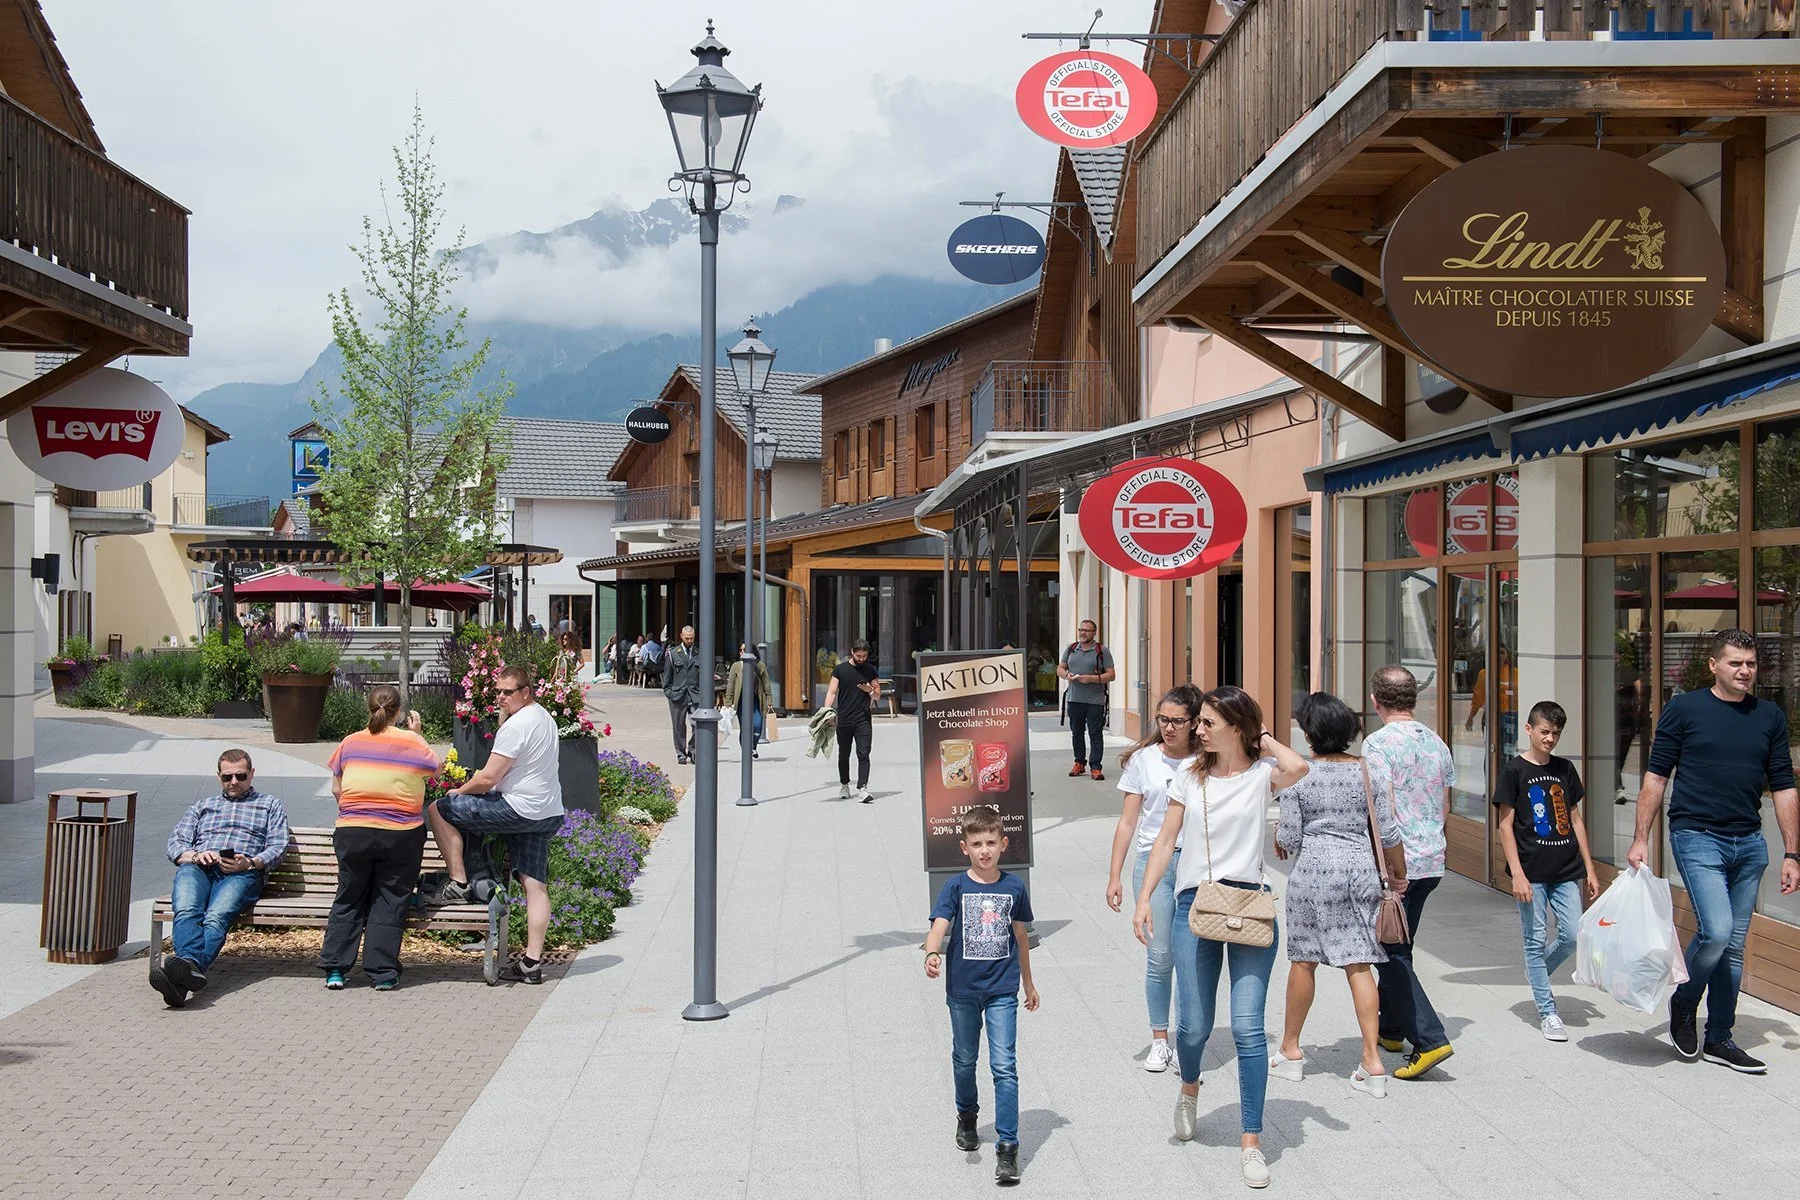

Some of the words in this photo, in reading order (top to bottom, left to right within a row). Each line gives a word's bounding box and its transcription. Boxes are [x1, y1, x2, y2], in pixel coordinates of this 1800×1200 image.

[1049, 61, 1090, 87] OFFICIAL
[1092, 62, 1123, 87] STORE
[1046, 91, 1128, 107] Tefal
[1050, 112, 1093, 138] OFFICIAL
[1095, 112, 1124, 137] STORE
[954, 244, 1039, 254] SKECHERS
[1442, 211, 1623, 270] Lindt
[1413, 286, 1483, 306] MAÎTRE
[1489, 289, 1628, 306] CHOCOLATIER
[1633, 289, 1695, 306] SUISSE
[1495, 310, 1561, 327] DEPUIS
[1568, 310, 1612, 327] 1845
[628, 421, 669, 430] HALLHUBER
[1119, 470, 1168, 502] OFFICIAL
[1171, 471, 1207, 502] STORE
[1115, 507, 1212, 529] Tefal
[1120, 535, 1168, 567] OFFICIAL
[1172, 535, 1207, 566] STORE
[924, 661, 1018, 694] AKTION
[926, 709, 946, 720] Jetzt
[947, 708, 976, 718] aktuell
[977, 708, 989, 716] im
[991, 706, 1020, 716] LINDT
[938, 719, 984, 729] Chocolate
[985, 718, 1009, 728] Shop
[951, 805, 957, 815] 3
[930, 816, 956, 824] Cornets
[932, 826, 954, 835] 20%
